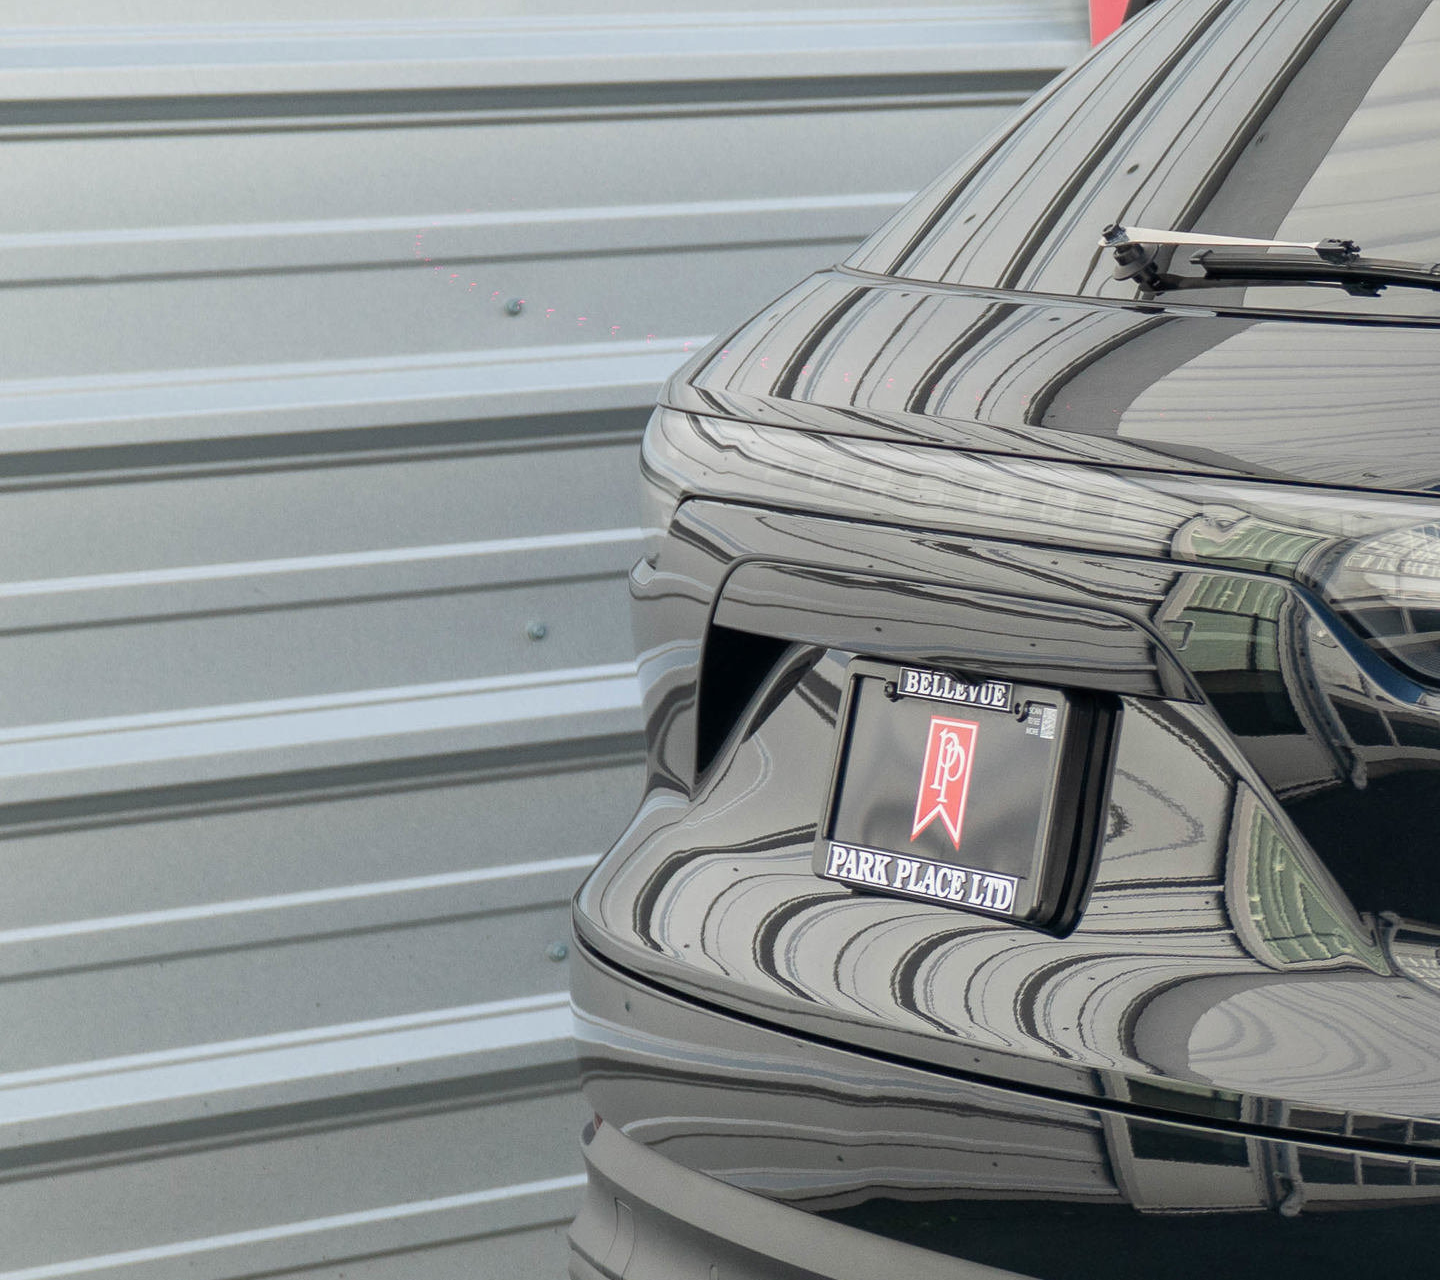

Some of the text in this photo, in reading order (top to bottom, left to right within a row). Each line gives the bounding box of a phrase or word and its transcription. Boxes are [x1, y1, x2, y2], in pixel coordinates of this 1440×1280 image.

[904, 671, 1006, 707] BELLEVUE
[828, 846, 1013, 911] PARK PLACE LTD
